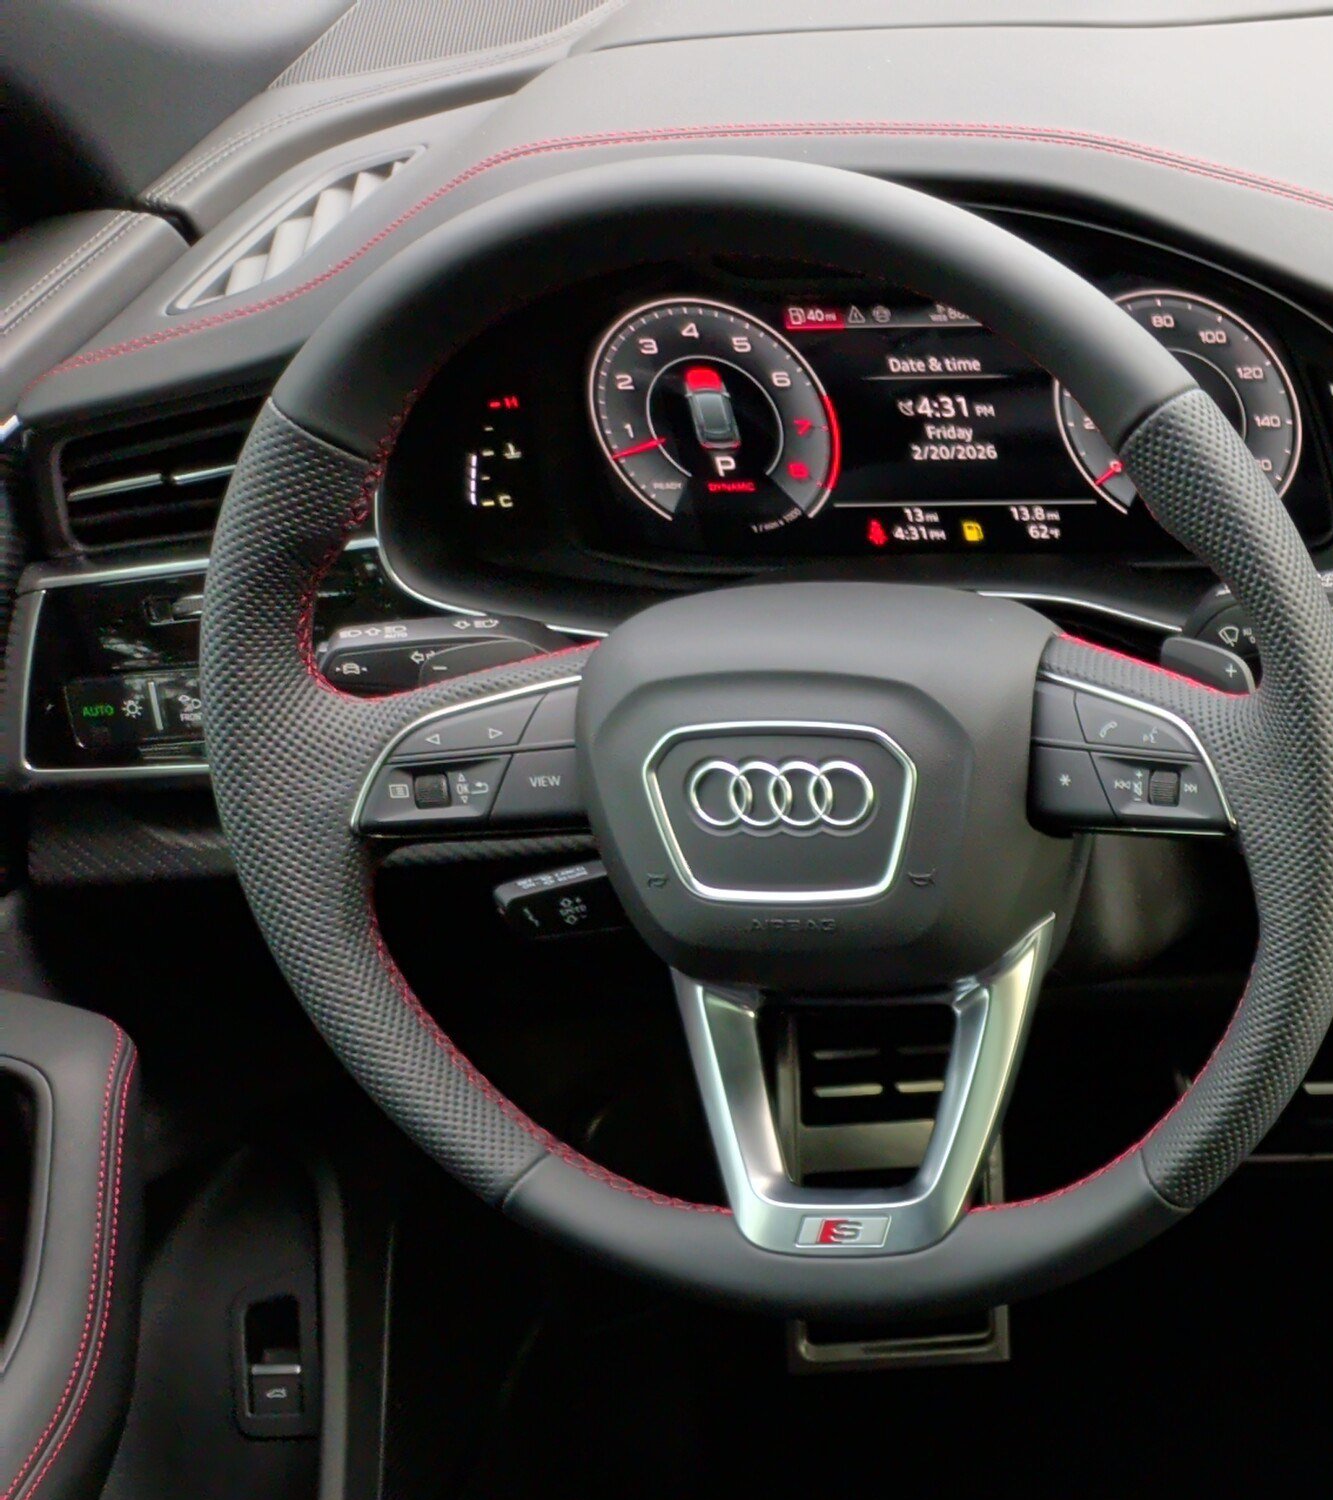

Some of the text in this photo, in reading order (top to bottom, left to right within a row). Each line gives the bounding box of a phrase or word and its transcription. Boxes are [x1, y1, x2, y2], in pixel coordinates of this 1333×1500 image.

[1152, 315, 1175, 329] 80
[680, 323, 699, 338] 4
[1199, 331, 1227, 344] 100
[639, 338, 658, 354] 3
[732, 337, 751, 352] 5
[888, 356, 982, 373] Date & time
[772, 372, 791, 387] 6
[1236, 367, 1264, 380] 120
[615, 374, 635, 390] 2
[917, 396, 996, 418] 4:31 PM
[793, 419, 812, 436] 7
[1254, 416, 1282, 428] 140
[624, 423, 634, 439] 1
[925, 425, 973, 443] Friday
[912, 444, 998, 461] 2/20/2026
[715, 456, 736, 477] P
[708, 482, 756, 493] DYNAMIC
[82, 704, 115, 717] AUTO
[529, 775, 561, 788] VIEW
[456, 783, 469, 796] OK
